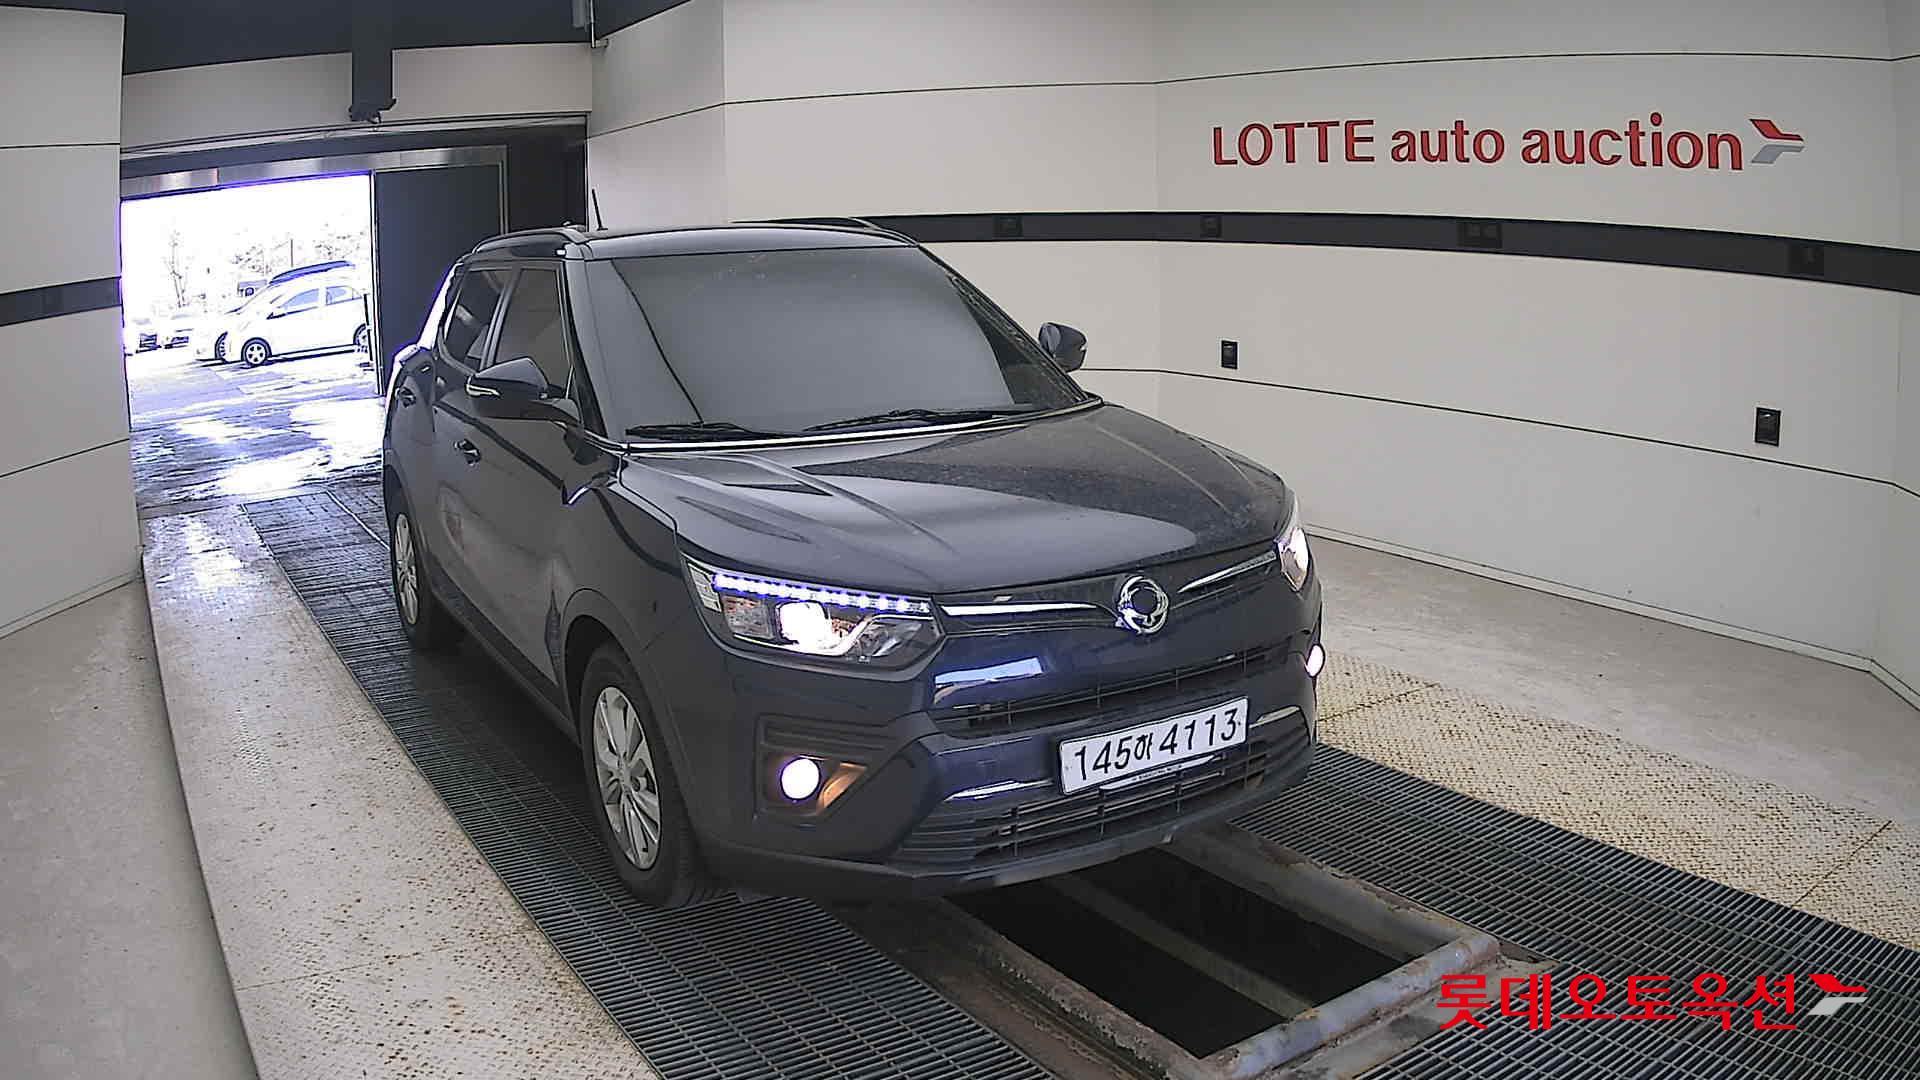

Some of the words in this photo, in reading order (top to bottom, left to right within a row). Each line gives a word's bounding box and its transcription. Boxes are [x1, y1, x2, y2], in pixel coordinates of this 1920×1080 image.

[1213, 120, 1375, 166] LOTTE
[1390, 119, 1505, 164] auto
[1520, 111, 1744, 171] auction
[1159, 708, 1239, 755] 4113
